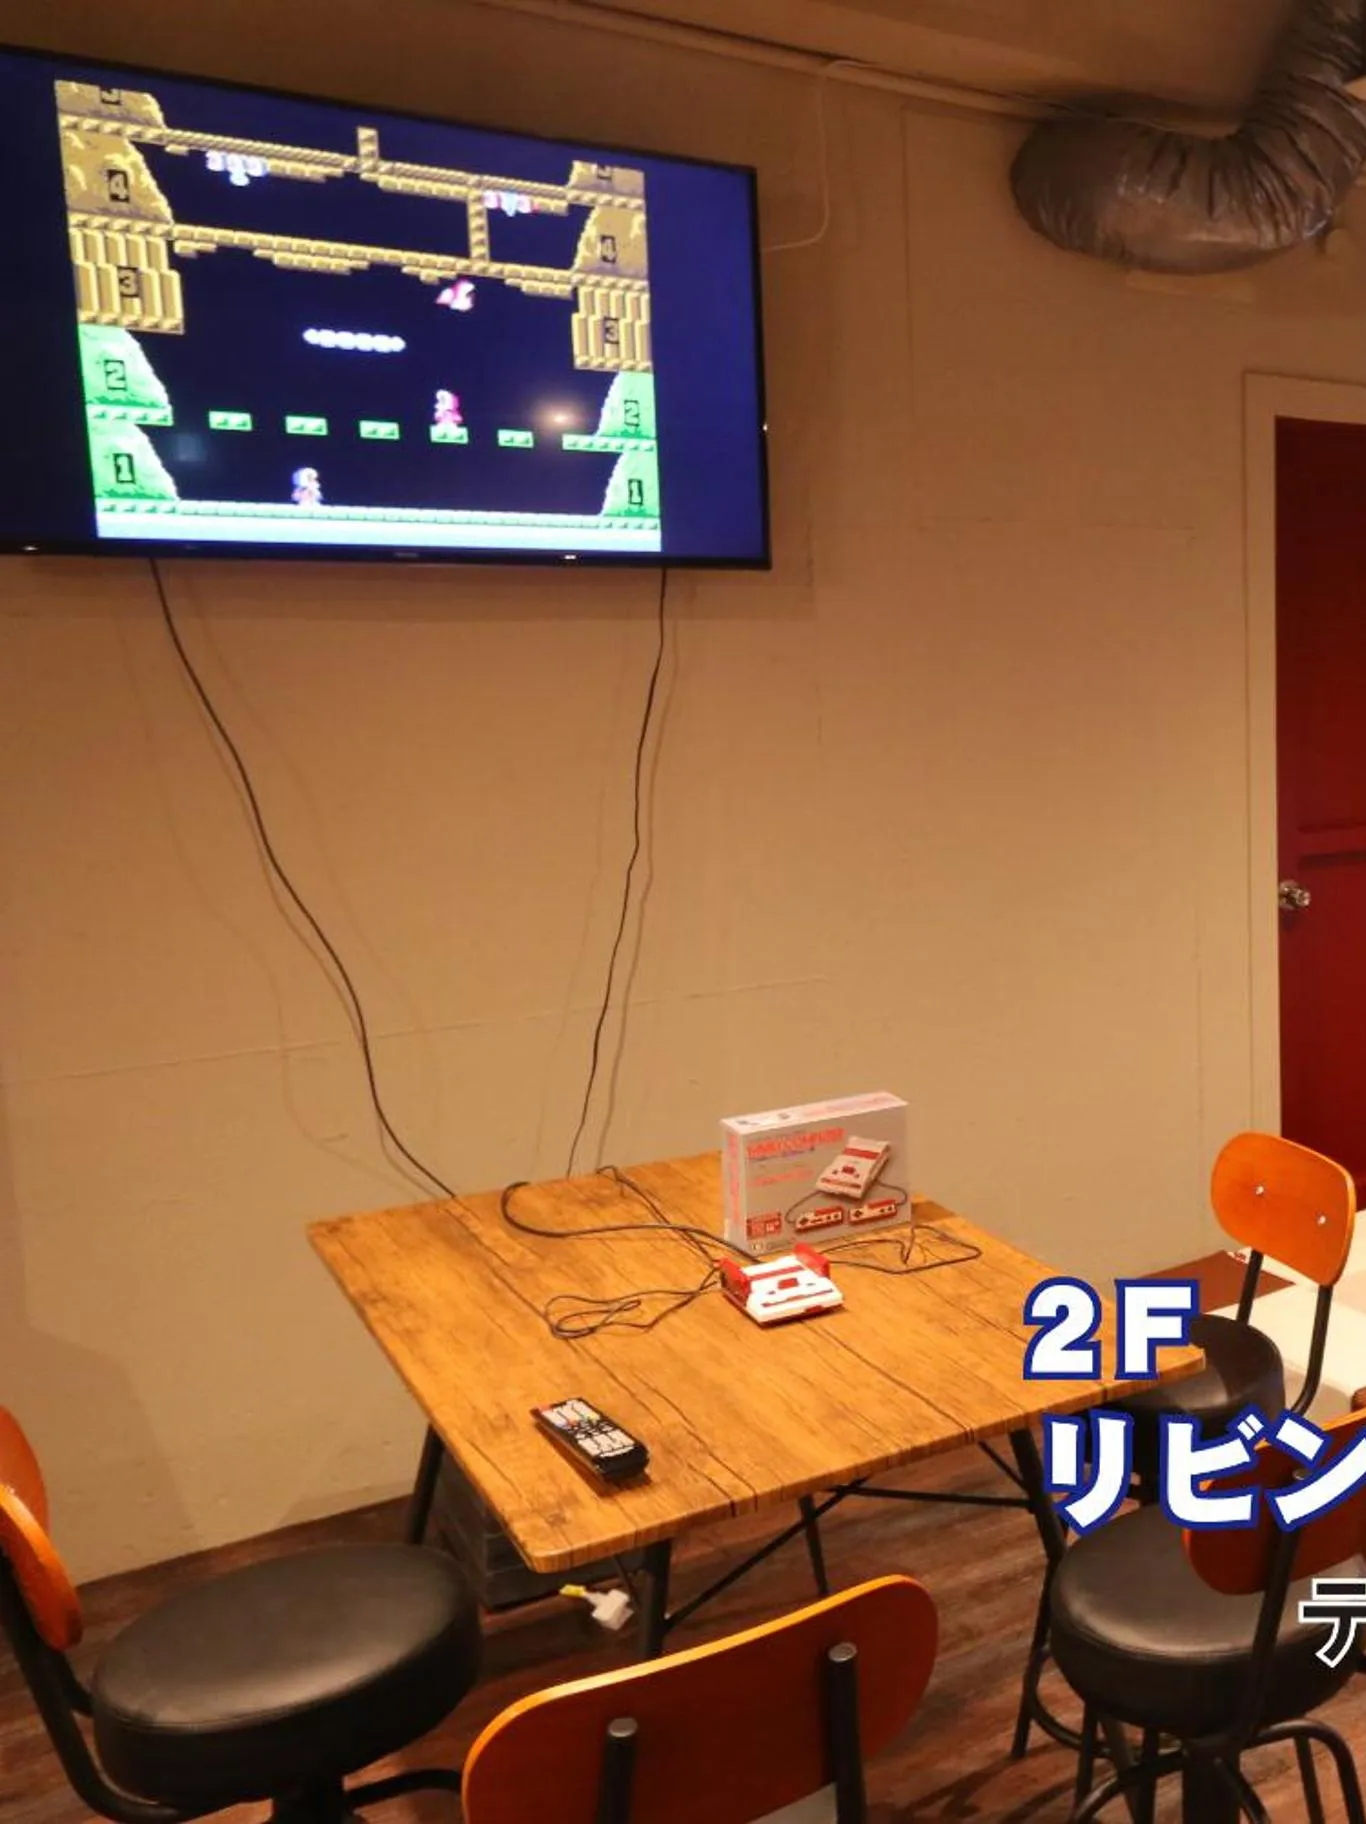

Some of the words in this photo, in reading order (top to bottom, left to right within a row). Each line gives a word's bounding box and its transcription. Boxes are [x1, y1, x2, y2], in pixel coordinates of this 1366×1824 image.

[107, 168, 129, 202] 4
[600, 234, 617, 264] 4
[117, 266, 139, 297] 3
[604, 316, 620, 345] 3
[104, 359, 127, 391] 2
[624, 399, 640, 427] 2
[113, 452, 135, 484] 1
[628, 478, 643, 505] 1
